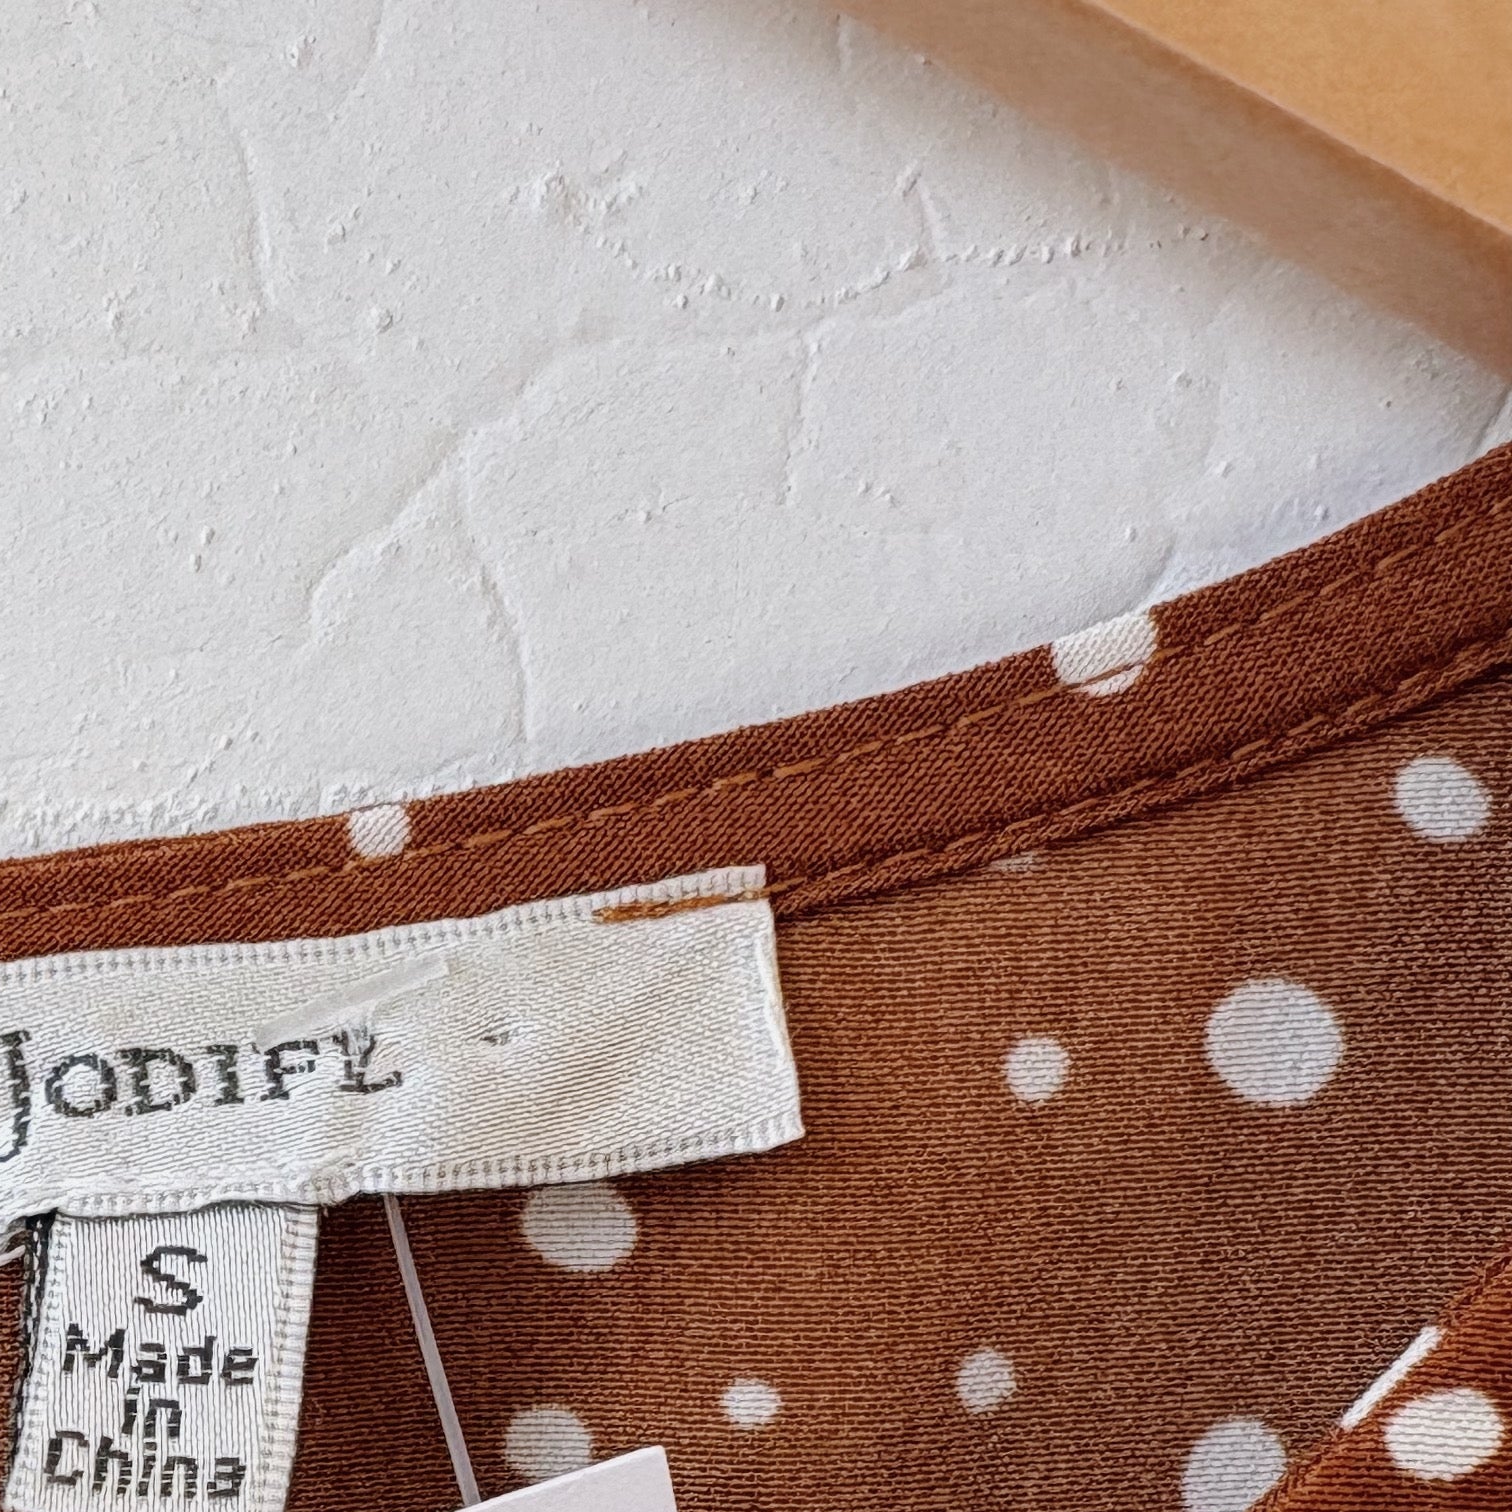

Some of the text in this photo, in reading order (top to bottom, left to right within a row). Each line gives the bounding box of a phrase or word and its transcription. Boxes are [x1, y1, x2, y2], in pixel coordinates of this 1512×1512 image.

[134, 1246, 208, 1316] S
[63, 1323, 258, 1385] Made
[121, 1387, 182, 1438] in
[43, 1430, 246, 1498] China
